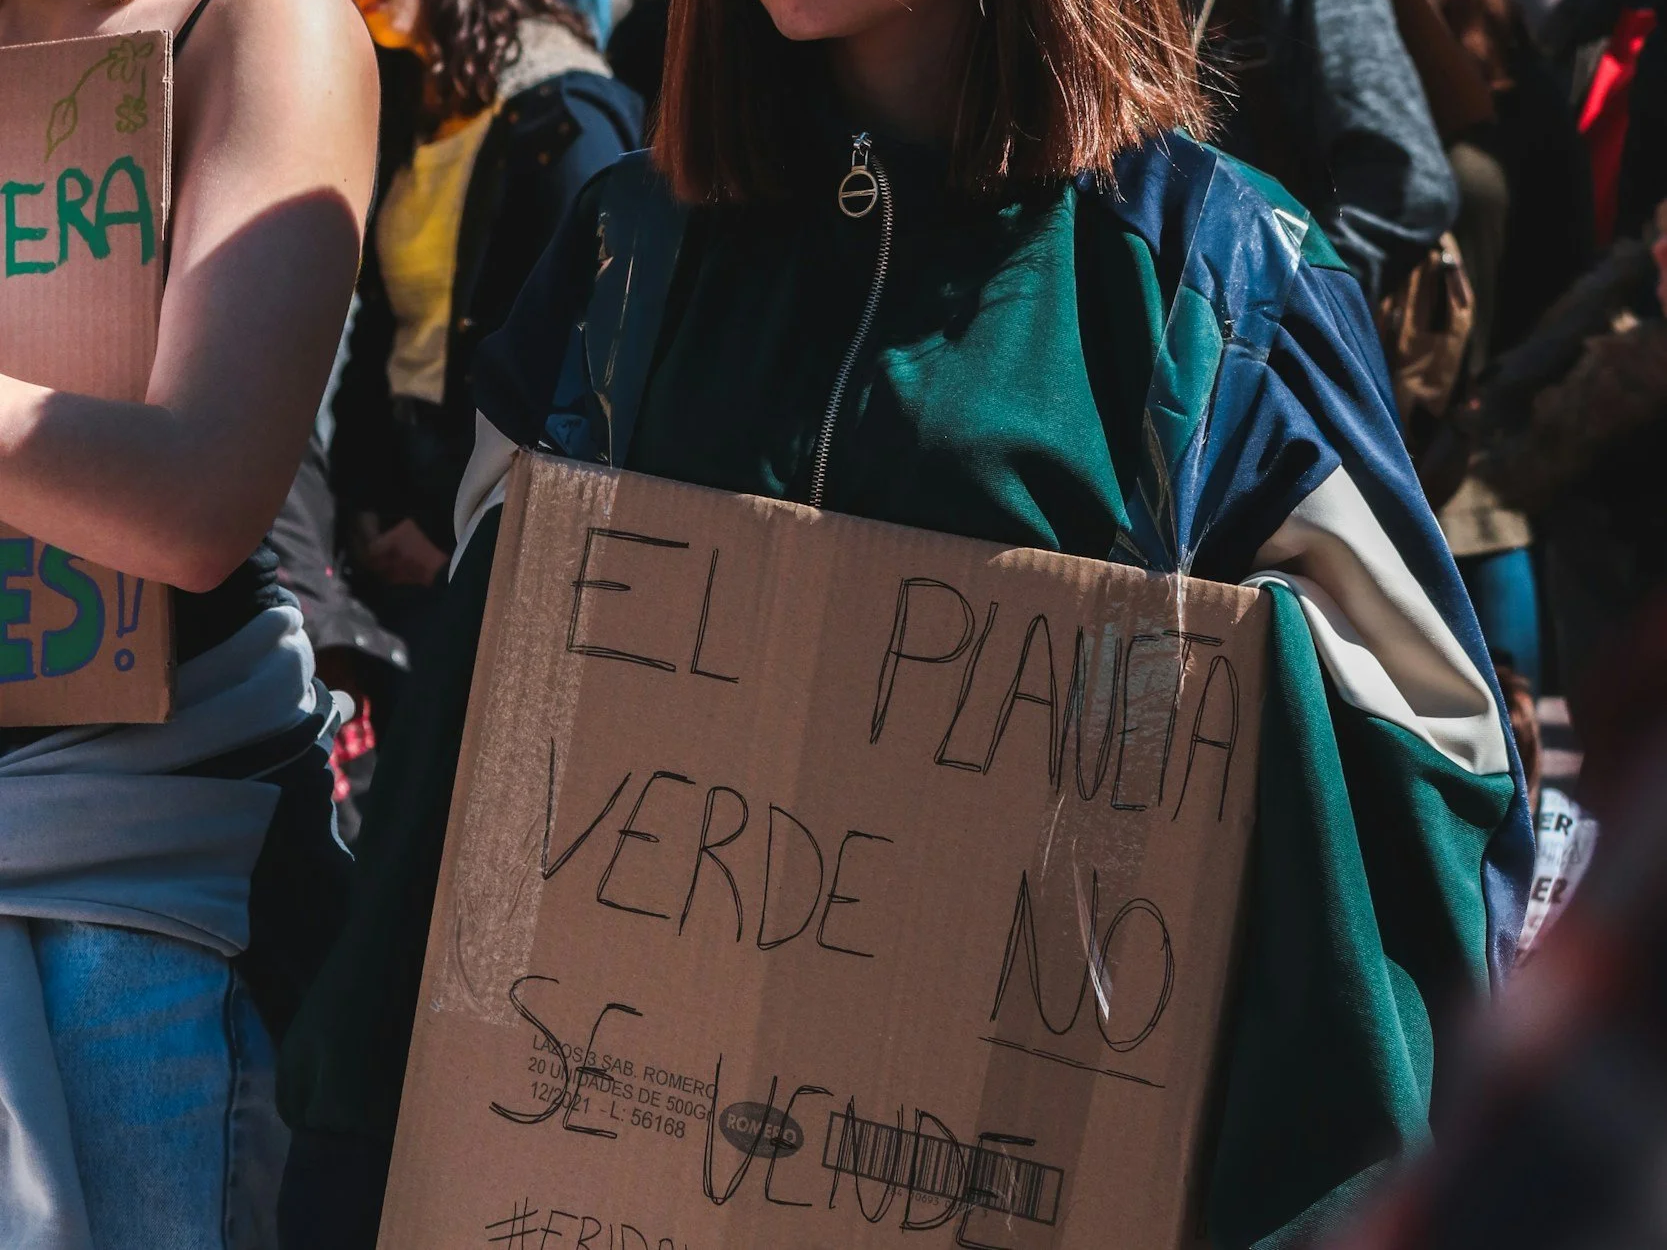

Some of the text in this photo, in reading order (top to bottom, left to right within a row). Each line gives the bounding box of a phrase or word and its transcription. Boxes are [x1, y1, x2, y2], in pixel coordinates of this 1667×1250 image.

[0, 155, 156, 278] ERA
[566, 527, 1240, 823] EL PLANETA
[541, 736, 1175, 1053] VERDE NO
[489, 974, 643, 1139] SE
[528, 1057, 547, 1075] 20
[549, 1061, 633, 1101] UNIDADES
[637, 1089, 662, 1108] DE
[532, 1034, 584, 1063] LAZOS
[600, 1054, 638, 1079] SAB.
[643, 1065, 718, 1100] ROMERO
[530, 1081, 590, 1115] 12/2021
[630, 1111, 686, 1139] 56168
[726, 1113, 797, 1146] ROMERO
